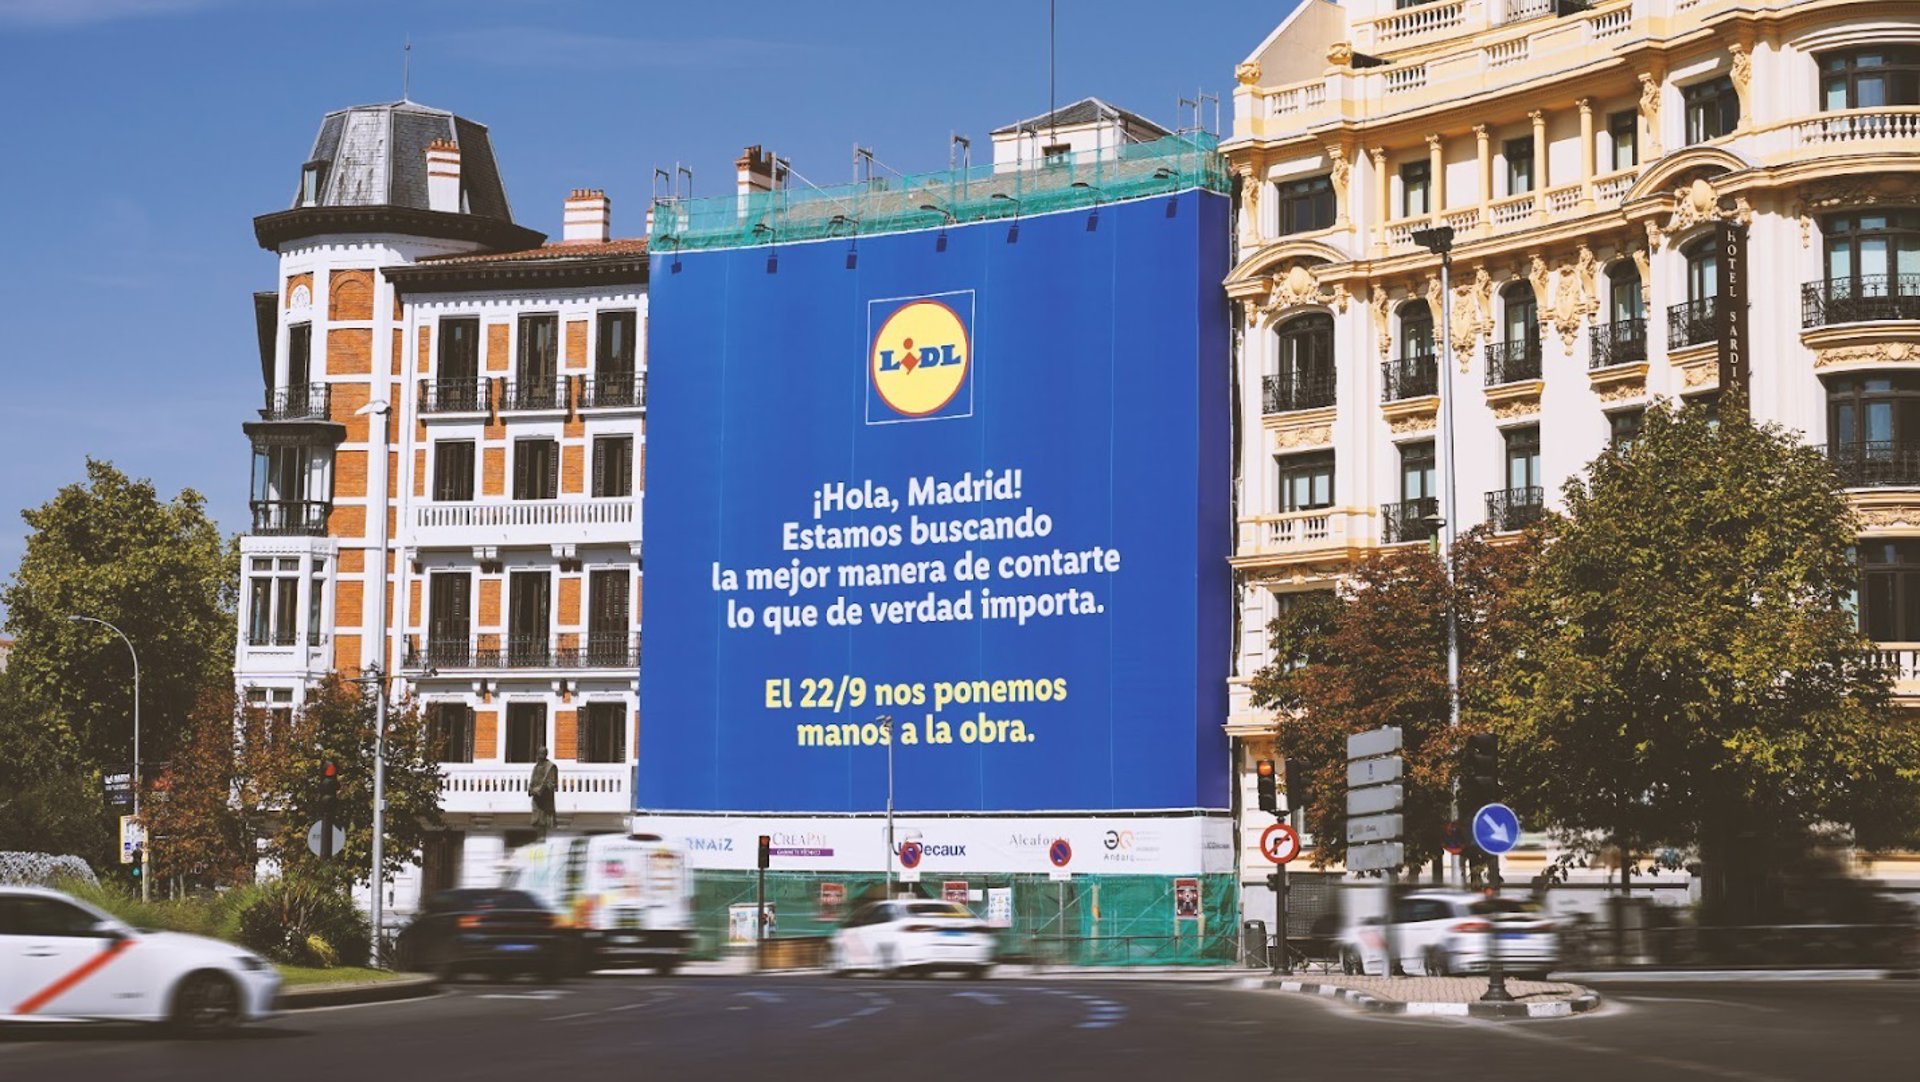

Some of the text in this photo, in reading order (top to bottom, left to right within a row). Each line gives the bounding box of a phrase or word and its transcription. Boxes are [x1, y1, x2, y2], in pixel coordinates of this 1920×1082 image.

[1727, 230, 1737, 298] HOTEL
[813, 468, 1022, 520] ¡Hola, Madrid!
[782, 507, 1053, 551] Estamos buscando
[711, 547, 1121, 597] la mejor manera de contarte
[727, 588, 1105, 635] lo que de verdad importa.
[765, 676, 1068, 713] El 22/9 nos ponemos
[796, 712, 1035, 746] manos a la obra.
